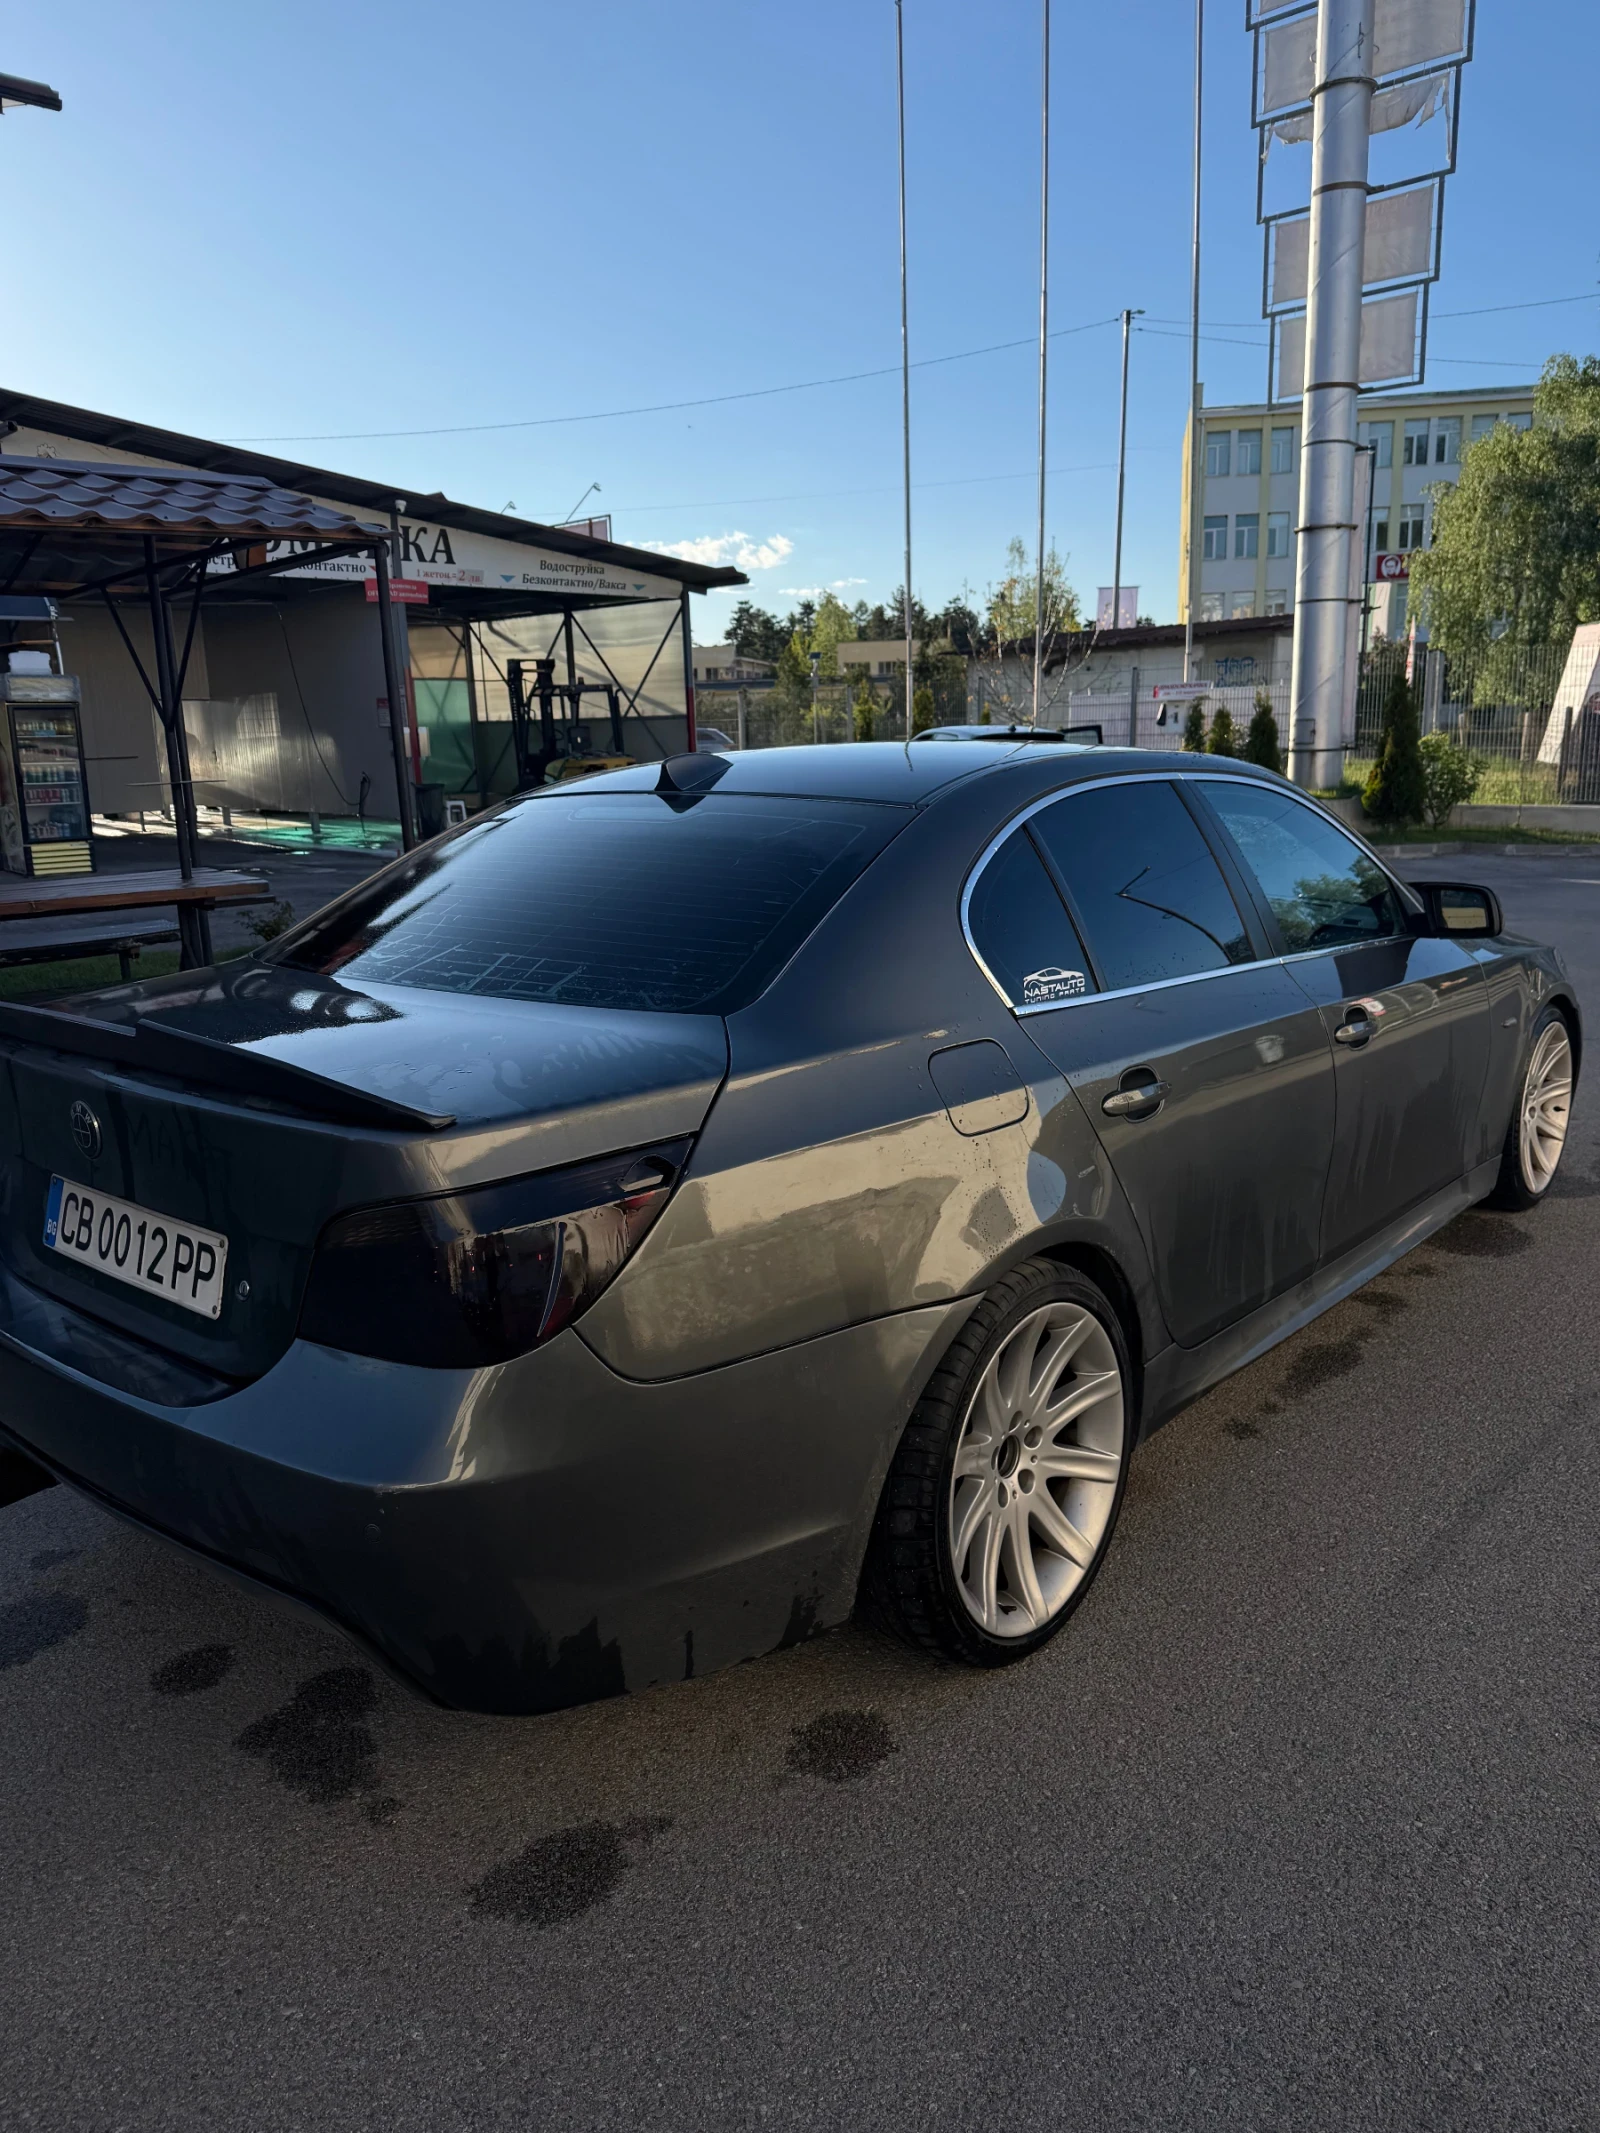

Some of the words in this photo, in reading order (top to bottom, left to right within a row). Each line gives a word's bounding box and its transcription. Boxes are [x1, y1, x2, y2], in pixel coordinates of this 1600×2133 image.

[458, 569, 466, 581] 2
[539, 559, 605, 576] Водоструйка
[521, 573, 627, 591] Безконтактно/Вакса
[1024, 978, 1085, 999] NASTAUTO
[1024, 993, 1055, 1004] TUNING
[1058, 987, 1086, 997] PARTS
[46, 1218, 57, 1236] BG
